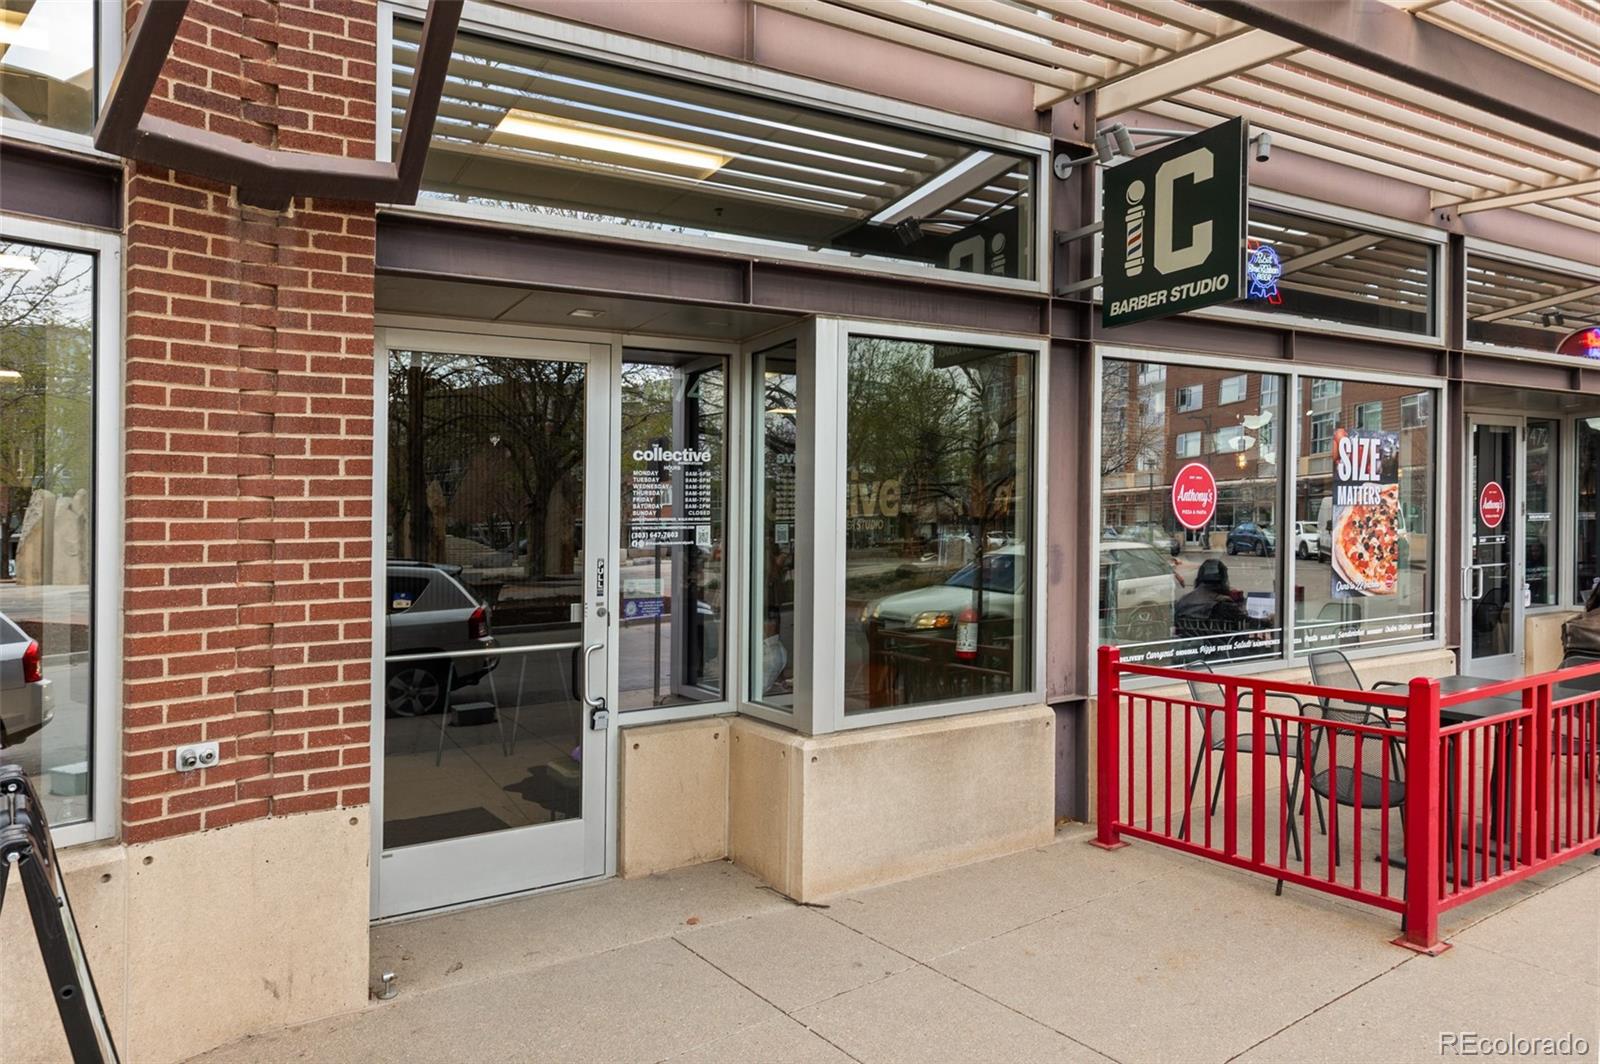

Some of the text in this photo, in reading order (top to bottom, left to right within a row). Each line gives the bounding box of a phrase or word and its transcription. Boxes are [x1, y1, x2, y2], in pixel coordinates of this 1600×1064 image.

[1109, 273, 1230, 316] BARBER STUDIO
[632, 447, 712, 462] collective
[1337, 435, 1381, 481] SIZE
[1177, 484, 1213, 508] Anthony's
[1337, 485, 1381, 505] MATTERS
[856, 518, 884, 530] STUDIO
[1146, 649, 1175, 660] Carryout
[1200, 645, 1216, 654] Pizza
